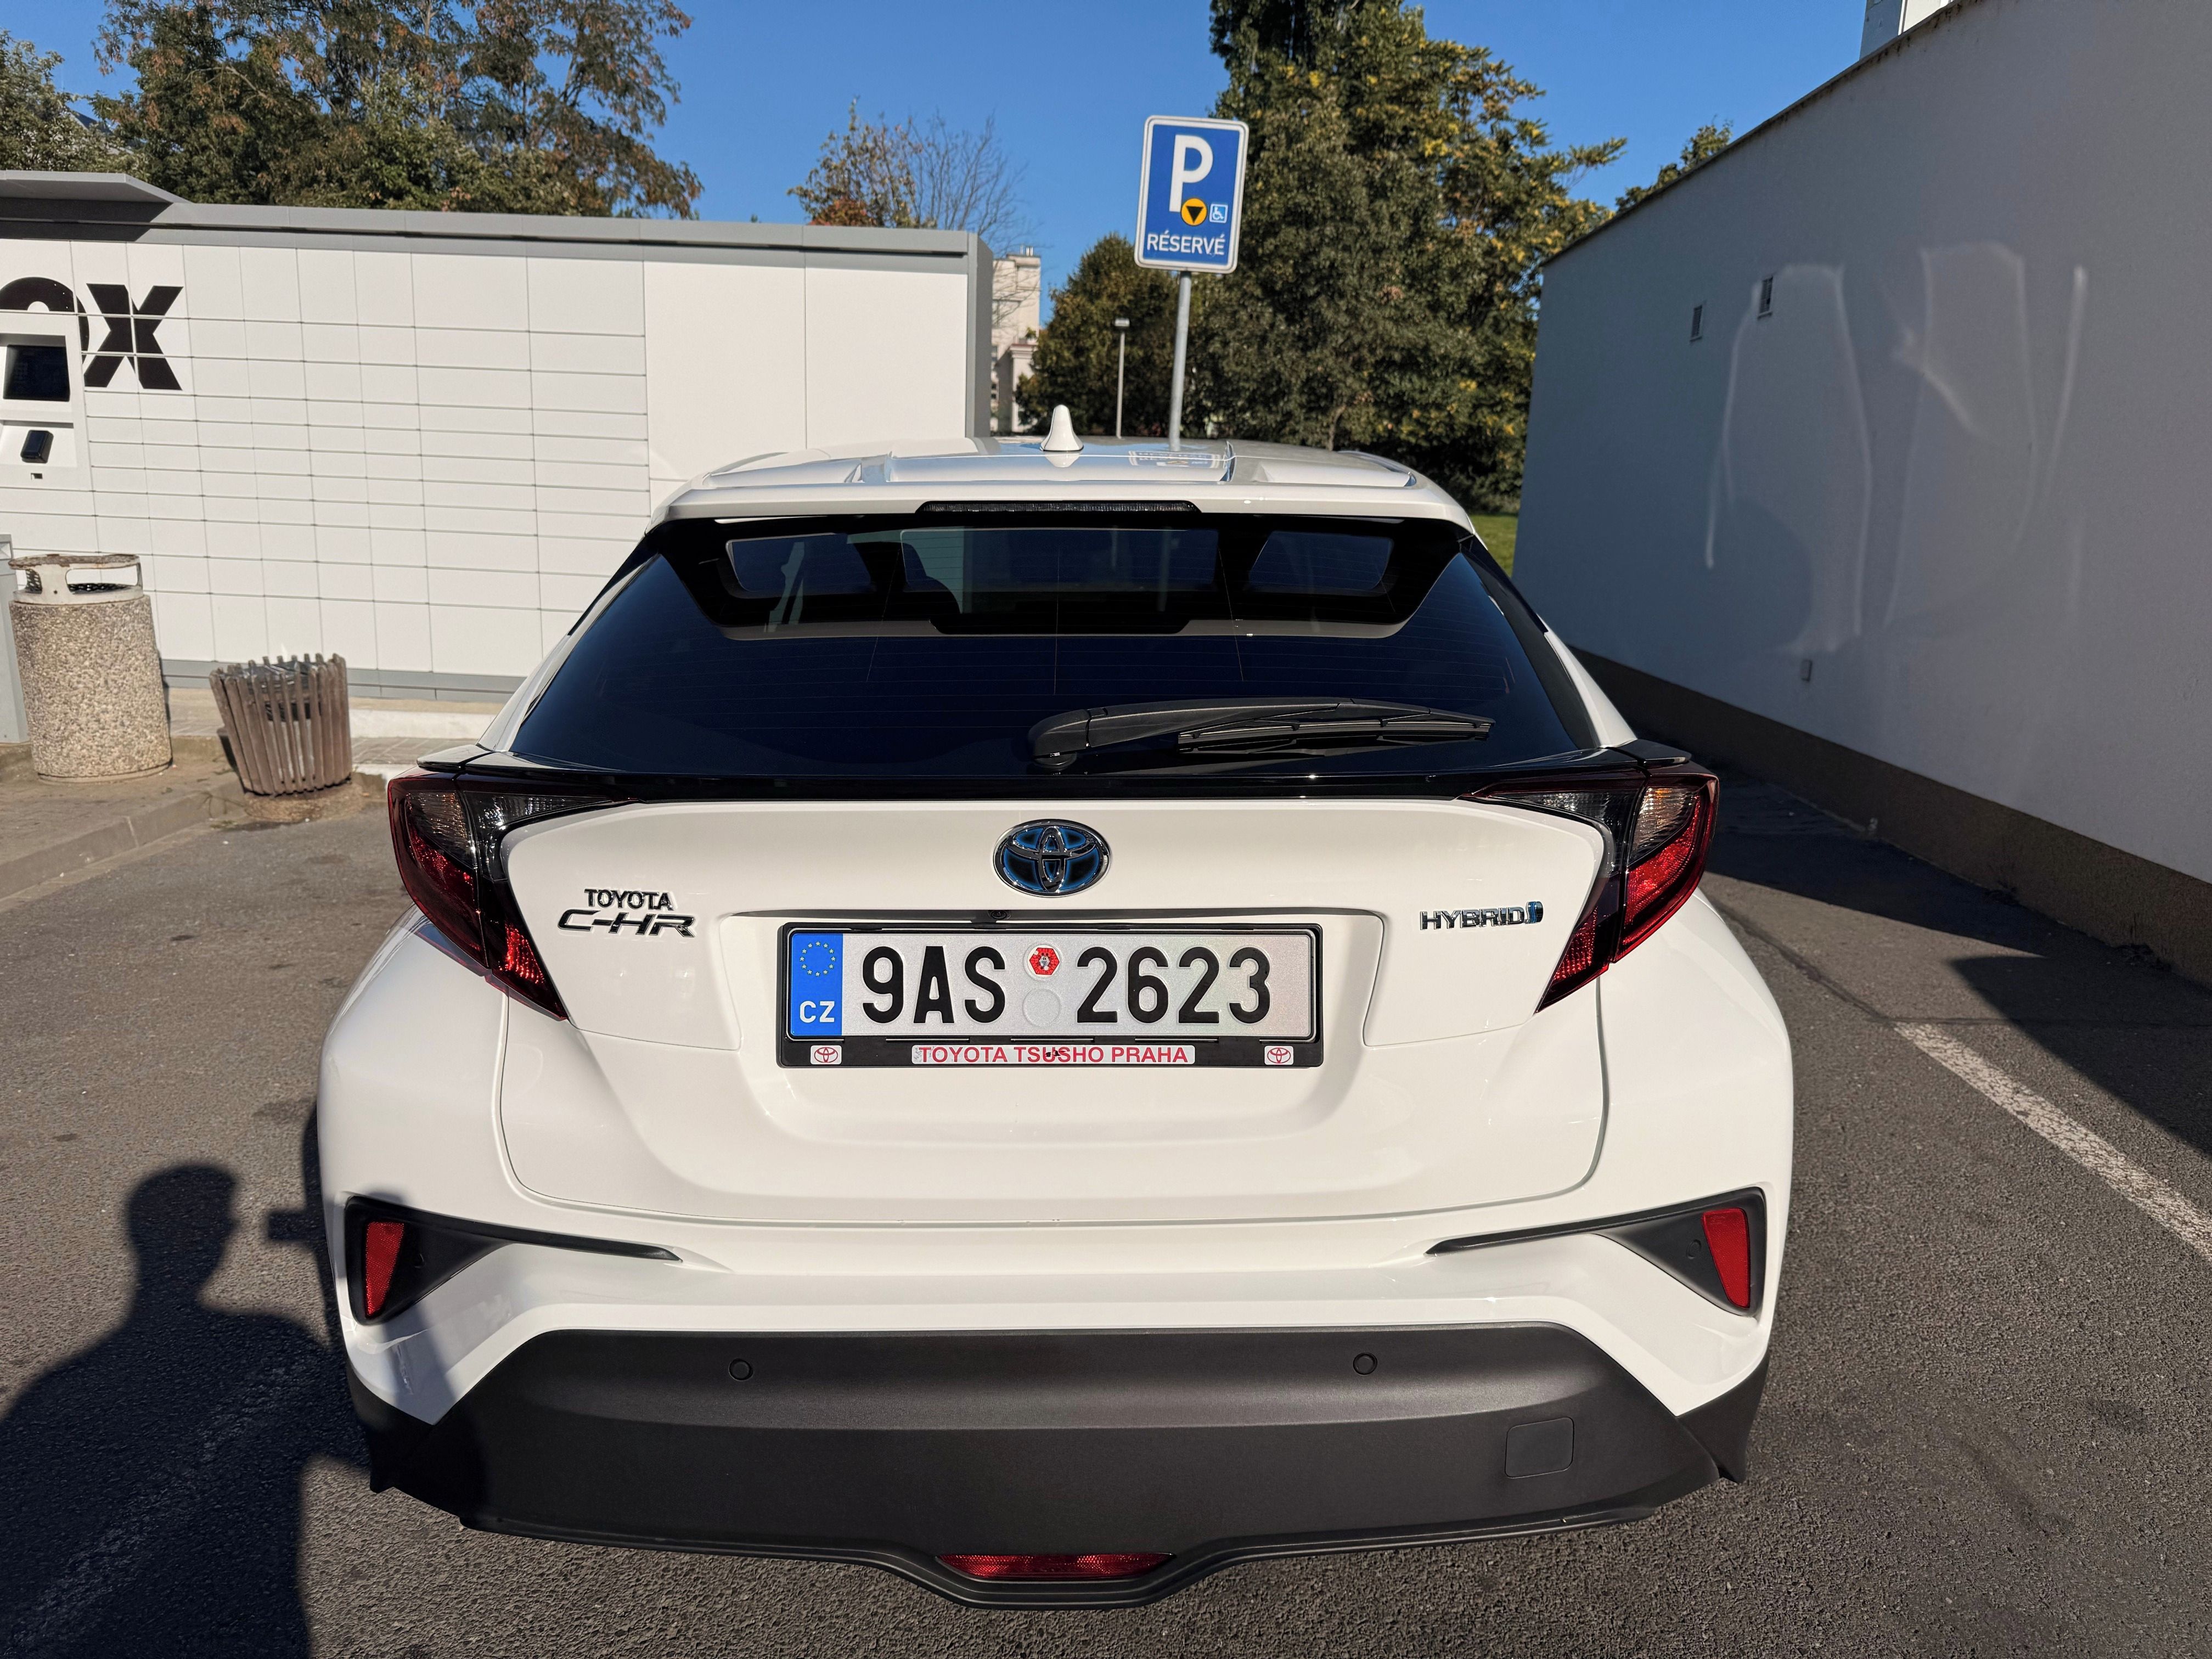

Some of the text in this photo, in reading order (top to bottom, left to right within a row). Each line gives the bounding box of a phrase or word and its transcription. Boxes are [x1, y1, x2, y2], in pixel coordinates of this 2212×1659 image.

[1169, 134, 1213, 212] P
[1147, 229, 1225, 256] RÉSERVÉ
[584, 888, 675, 910] TOYOTA
[558, 909, 695, 937] C-HR
[1420, 907, 1525, 930] HYBRID
[862, 946, 1271, 1024] 9AS 2623
[800, 1000, 835, 1023] CZ
[920, 1047, 1188, 1063] TOYOTA TSUSHO PRAHA
